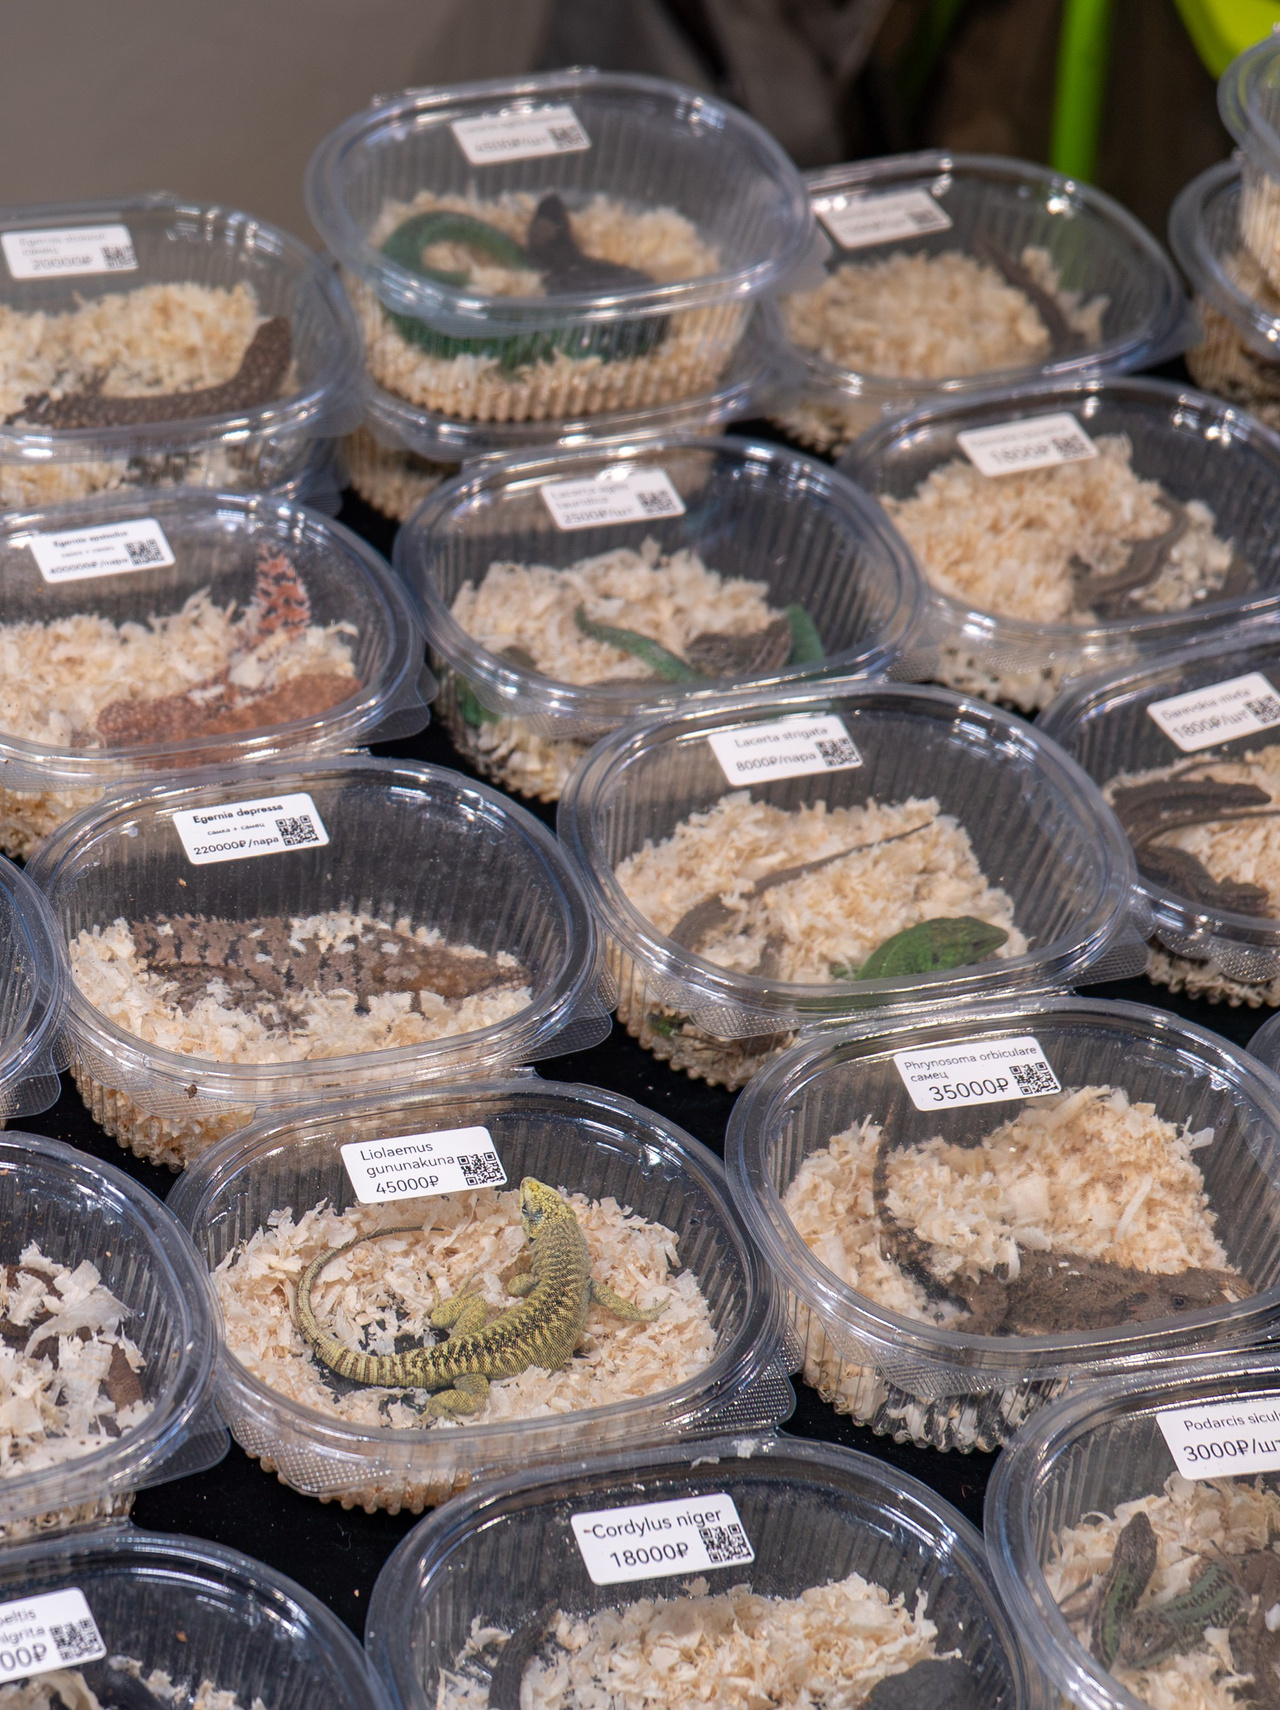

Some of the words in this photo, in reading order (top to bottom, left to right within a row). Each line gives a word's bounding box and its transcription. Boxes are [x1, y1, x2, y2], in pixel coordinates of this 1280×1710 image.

[735, 735, 780, 748] Lacerta
[782, 727, 828, 741] strigata
[736, 751, 816, 772] 8000₽/пара
[193, 810, 234, 825] Egernia
[237, 804, 283, 818] depressa
[904, 1055, 977, 1071] Phrynosoma
[979, 1046, 1037, 1061] orbiculare
[910, 1071, 949, 1083] самец
[929, 1078, 1009, 1101] 35000₽
[360, 1142, 433, 1161] Liolaemus
[366, 1154, 455, 1178] gununakuna
[375, 1175, 439, 1195] 45000₽
[1184, 1414, 1245, 1432] Podarcis
[1248, 1410, 1280, 1425] sicul
[593, 1518, 672, 1539] Cordylus
[677, 1509, 722, 1528] niger
[610, 1542, 689, 1568] 18000₽
